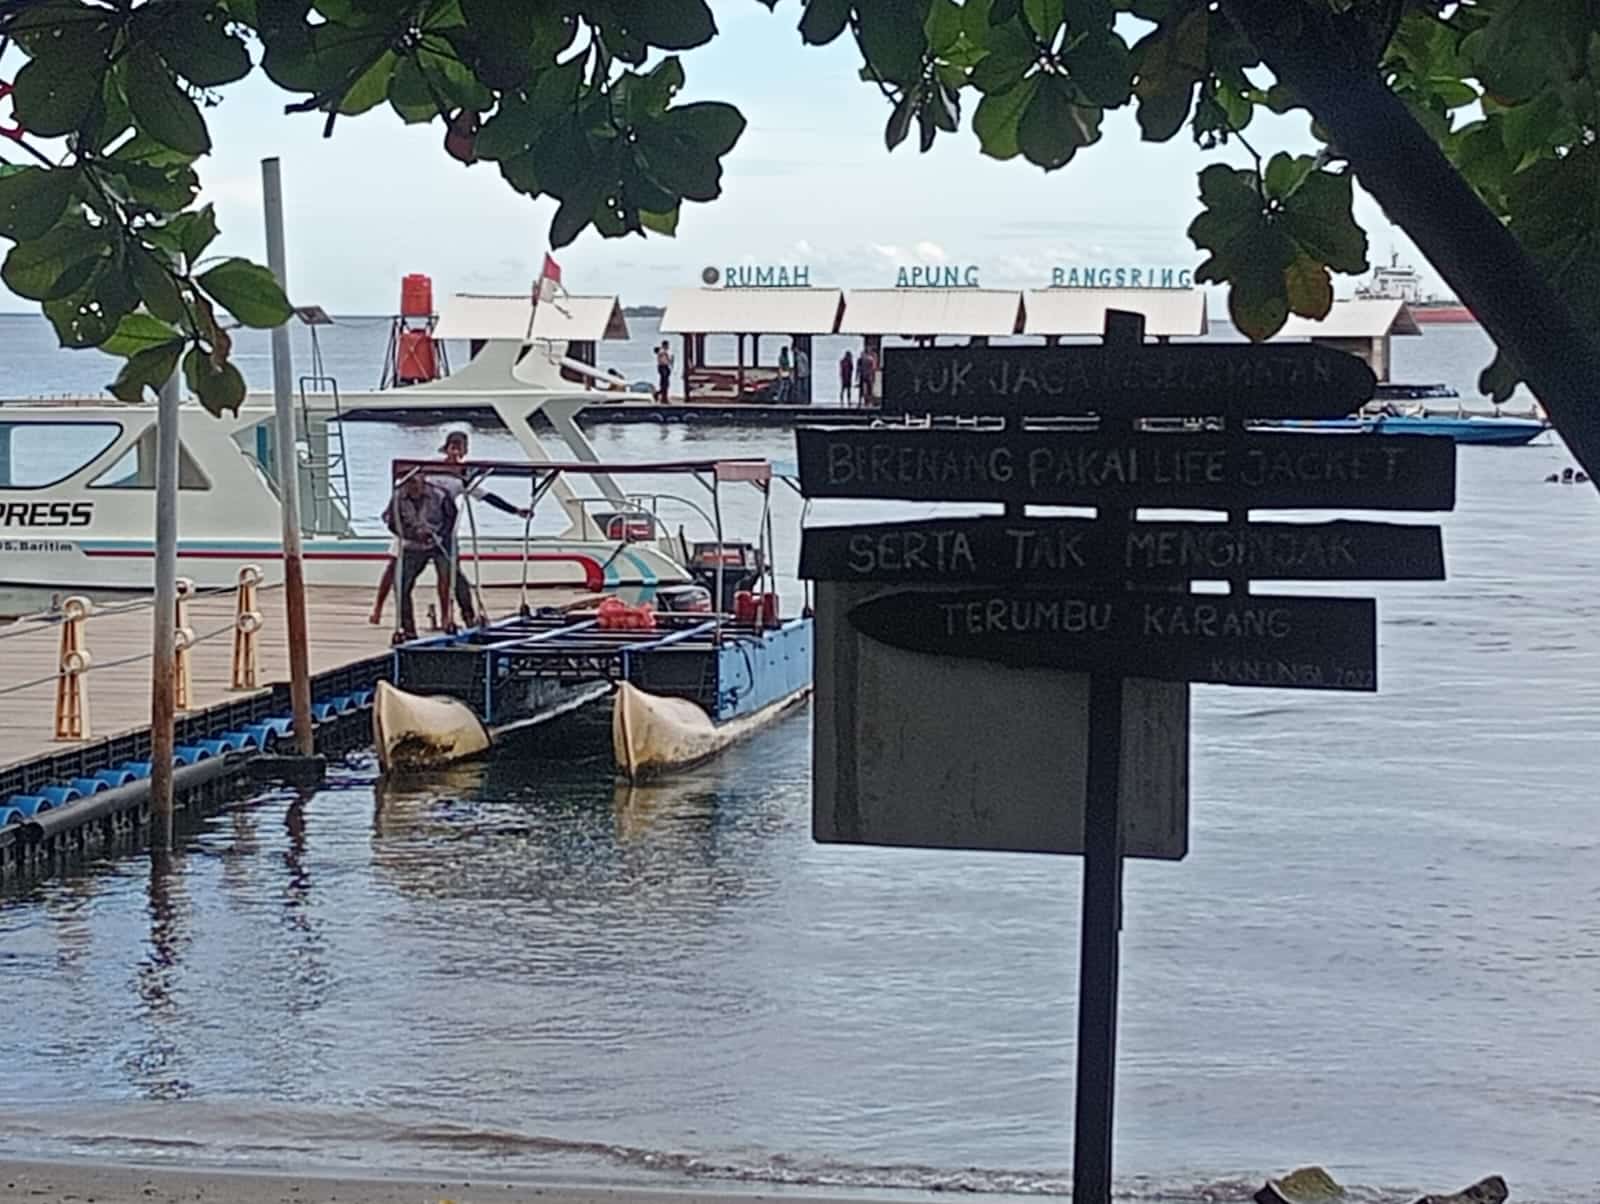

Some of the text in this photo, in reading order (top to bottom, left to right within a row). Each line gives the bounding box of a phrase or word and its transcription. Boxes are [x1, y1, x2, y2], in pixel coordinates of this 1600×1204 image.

[725, 265, 1193, 288] RUMAH APUNG BANGSRING
[1029, 447, 1137, 488] PAKAI
[1154, 448, 1226, 484] LIFE
[848, 530, 976, 573] SERTA
[1005, 530, 1087, 569] TAK
[936, 599, 1292, 638] TERUMBU KARANG
